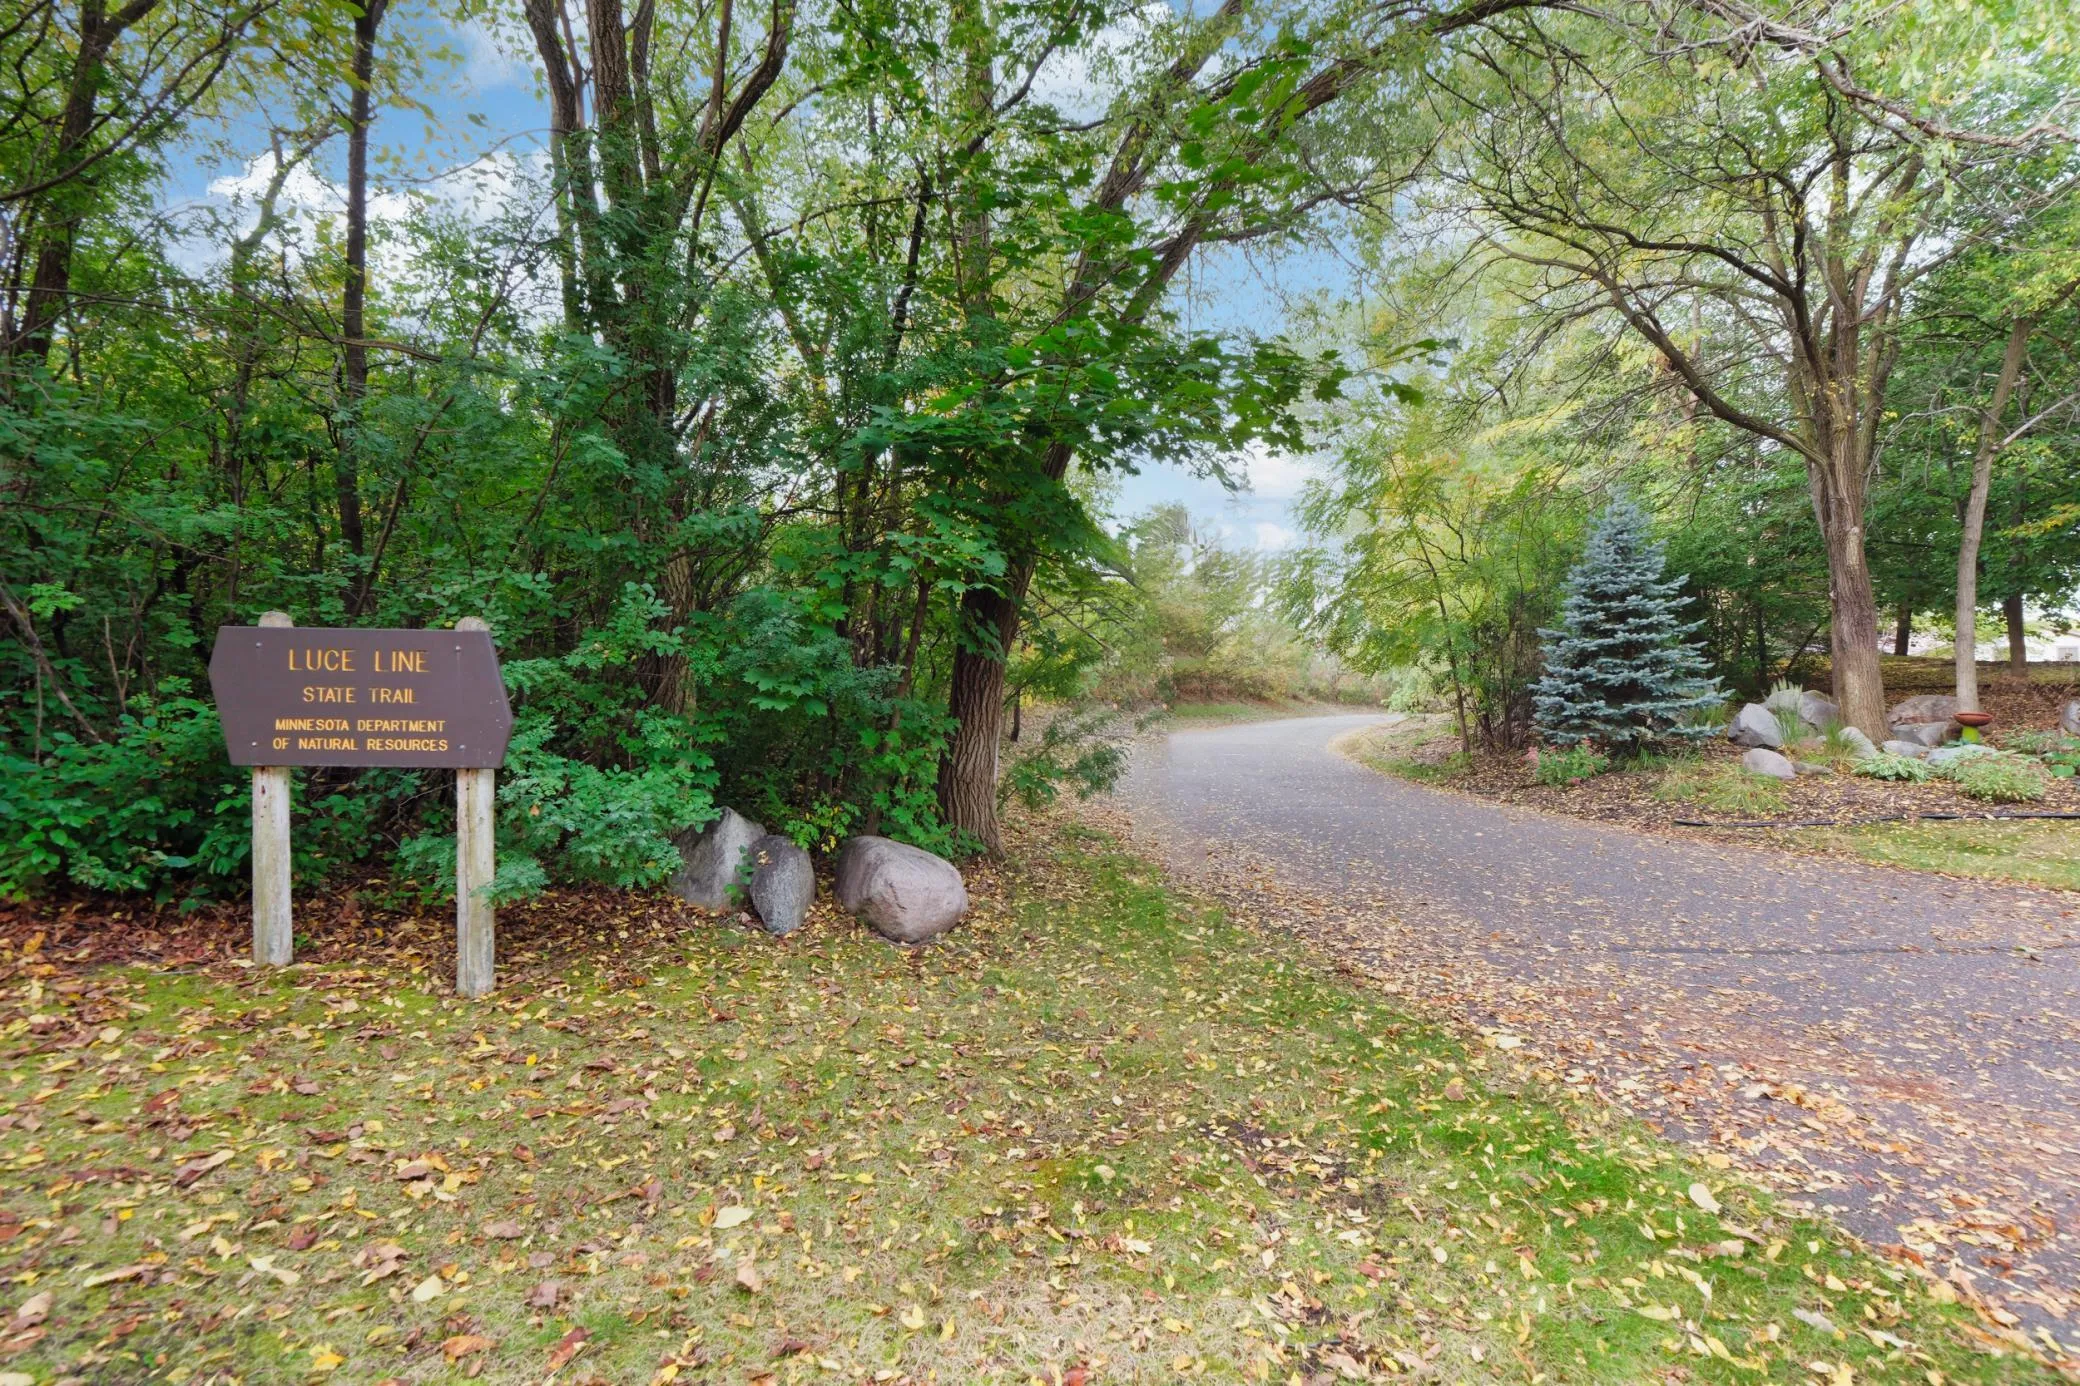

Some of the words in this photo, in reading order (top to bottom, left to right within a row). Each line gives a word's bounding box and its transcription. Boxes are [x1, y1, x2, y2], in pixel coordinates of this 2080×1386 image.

[288, 648, 356, 672] LUCE
[374, 649, 431, 673] LINE
[303, 686, 357, 704] STATE
[369, 687, 419, 704] TRAIL
[275, 718, 350, 732] MINNESOTA
[356, 719, 446, 733] DEPARTMENT
[272, 737, 291, 750] OF
[298, 737, 359, 751] NATURAL
[366, 738, 449, 752] RESOURCES
